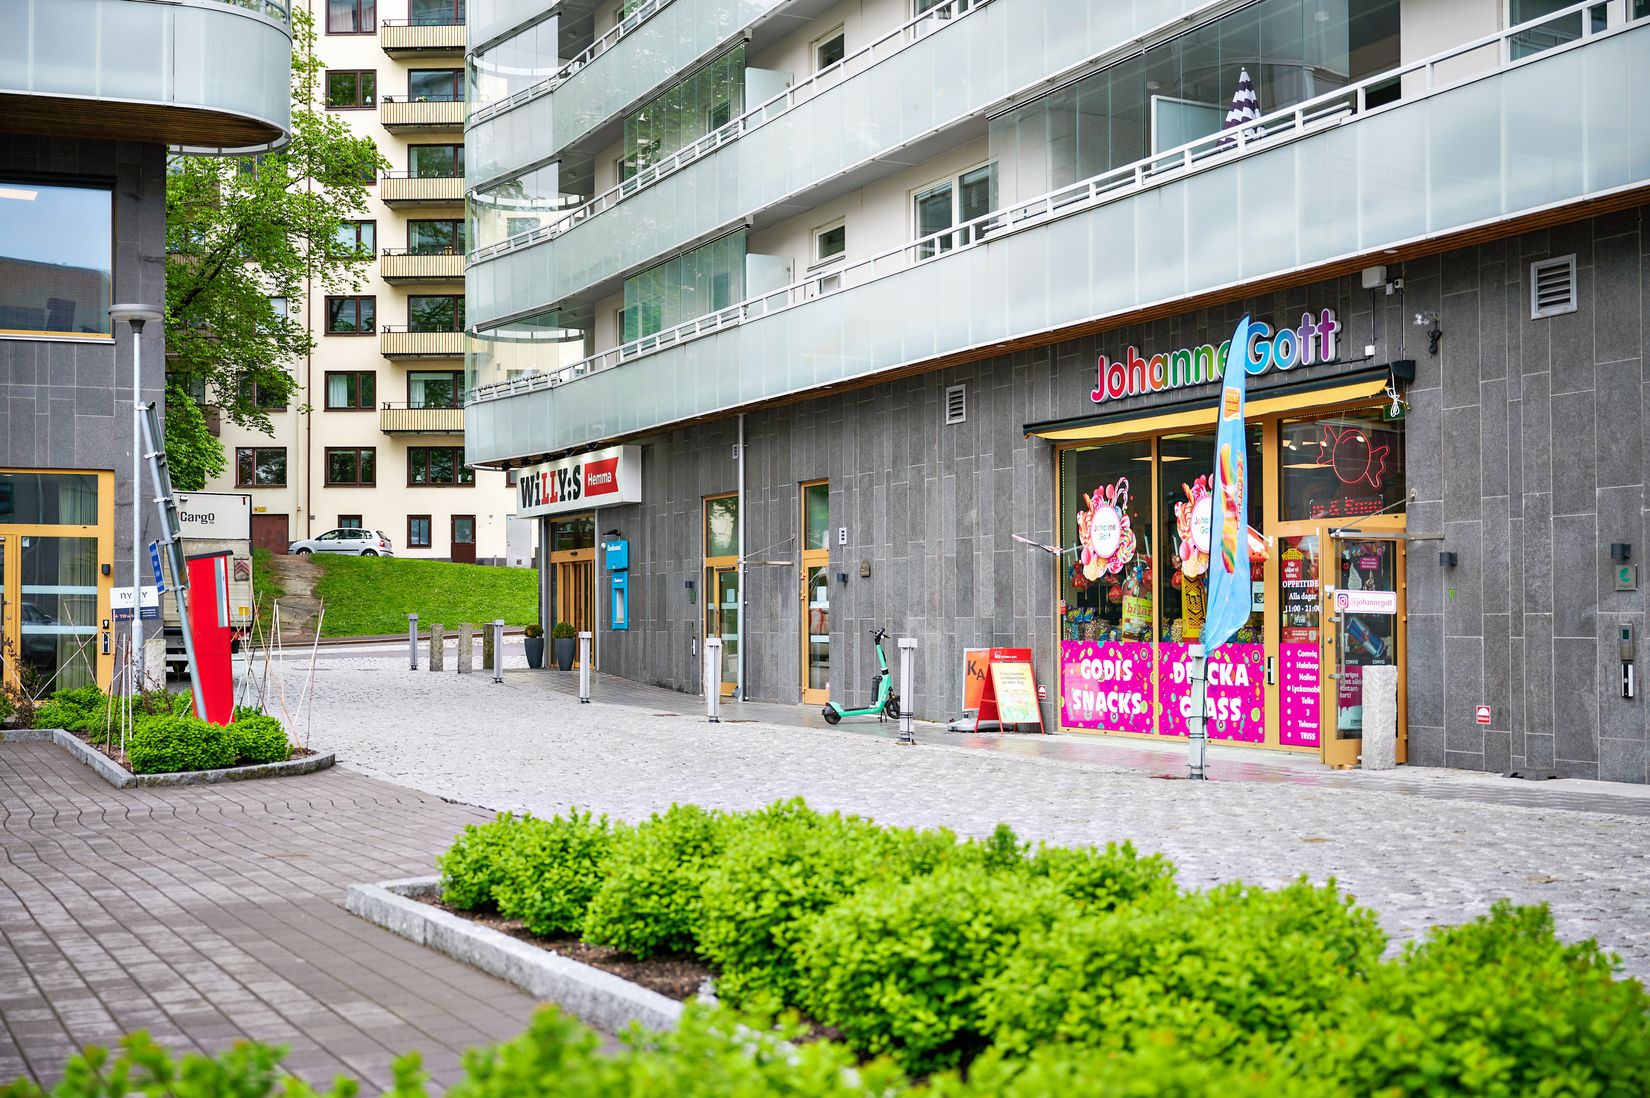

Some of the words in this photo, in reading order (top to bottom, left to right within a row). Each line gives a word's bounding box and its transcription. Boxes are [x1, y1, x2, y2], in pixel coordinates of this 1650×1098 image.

[1245, 308, 1340, 376] Gott
[587, 471, 612, 487] Hemma
[1194, 516, 1210, 525] Joha
[1094, 523, 1116, 532] Johanne
[1099, 532, 1111, 541] Gott
[1289, 592, 1300, 600] Alla
[1301, 592, 1317, 602] dagar
[1351, 597, 1393, 609] @johannegott
[1297, 650, 1317, 659] Comviq
[1080, 659, 1133, 682] GODIS
[1298, 673, 1317, 681] Hallon
[1072, 688, 1142, 715] SNACKS
[1179, 695, 1242, 721] GASS
[1305, 708, 1310, 716] 3
[1298, 720, 1318, 728] Telenor
[1300, 732, 1316, 740] TRISS
